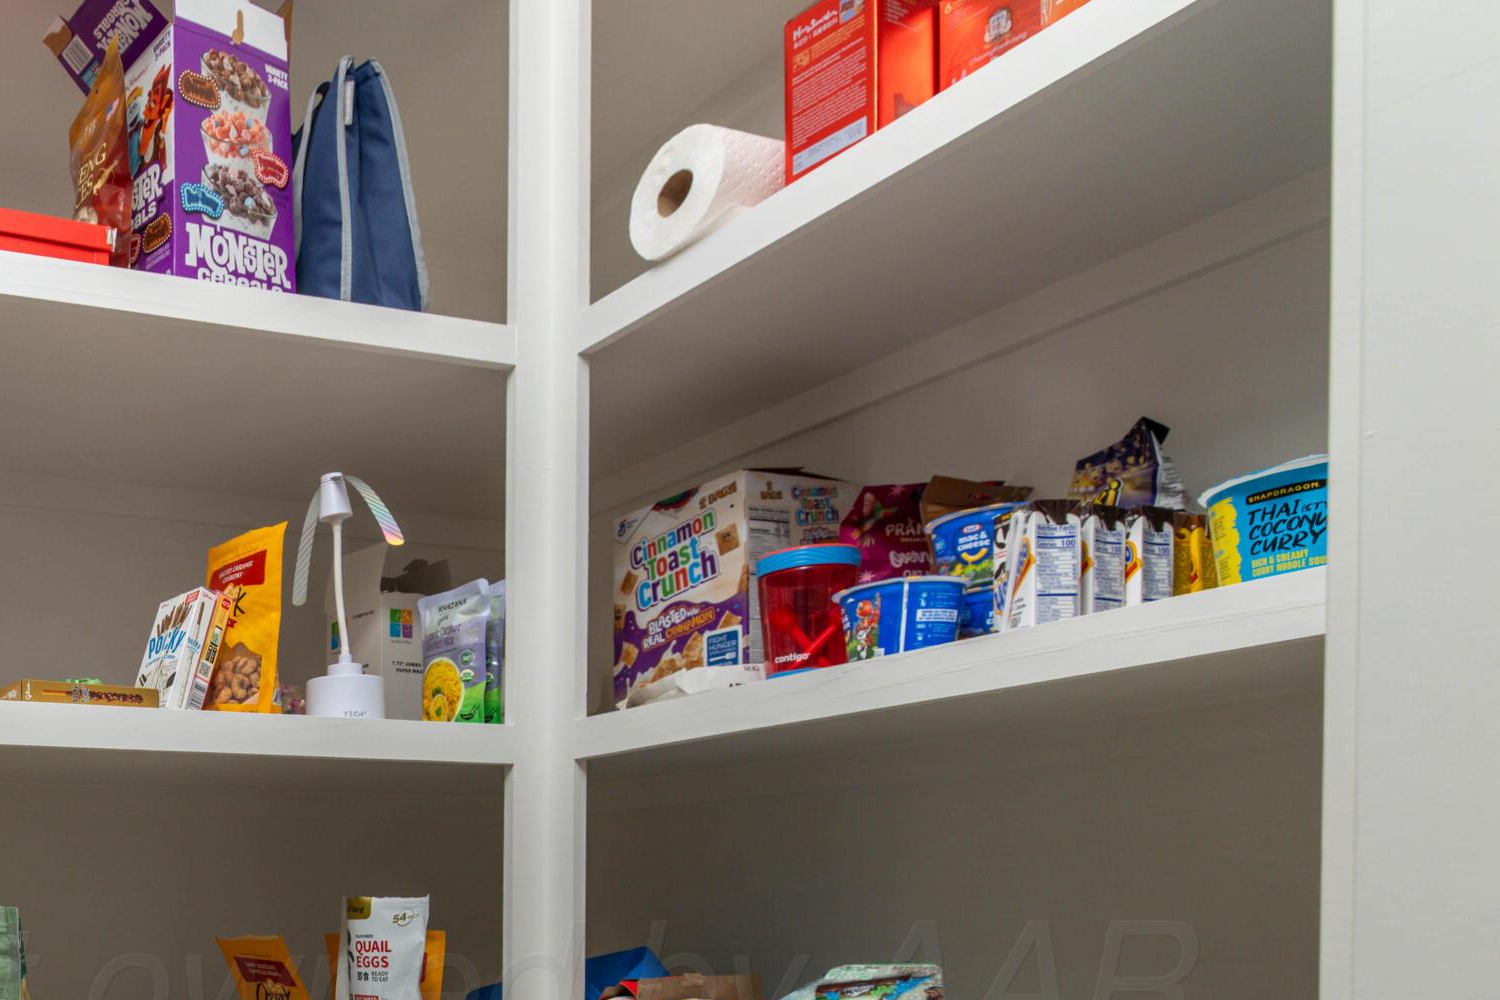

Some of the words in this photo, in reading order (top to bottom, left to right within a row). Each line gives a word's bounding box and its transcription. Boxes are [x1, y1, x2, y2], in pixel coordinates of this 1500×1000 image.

[264, 63, 289, 81] VARIETY
[267, 74, 289, 91] 3-PACK
[1248, 481, 1320, 504] SNAPDRAGON
[1248, 499, 1300, 526] THAI
[631, 509, 716, 568] Cinnamon
[956, 540, 990, 552] cheese
[958, 535, 981, 545] mac
[1060, 539, 1076, 548] 100
[1251, 525, 1327, 556] CURRY
[647, 537, 700, 582] Toast
[637, 549, 718, 610] Crunch
[643, 633, 665, 649] REAL
[666, 611, 713, 639] CINNAMON
[648, 608, 687, 635] BLASTED
[708, 640, 737, 651] HUNGER
[775, 652, 810, 664] contigo
[392, 912, 407, 924] 54
[355, 940, 392, 954] QUAIL
[356, 955, 389, 968] EGGS
